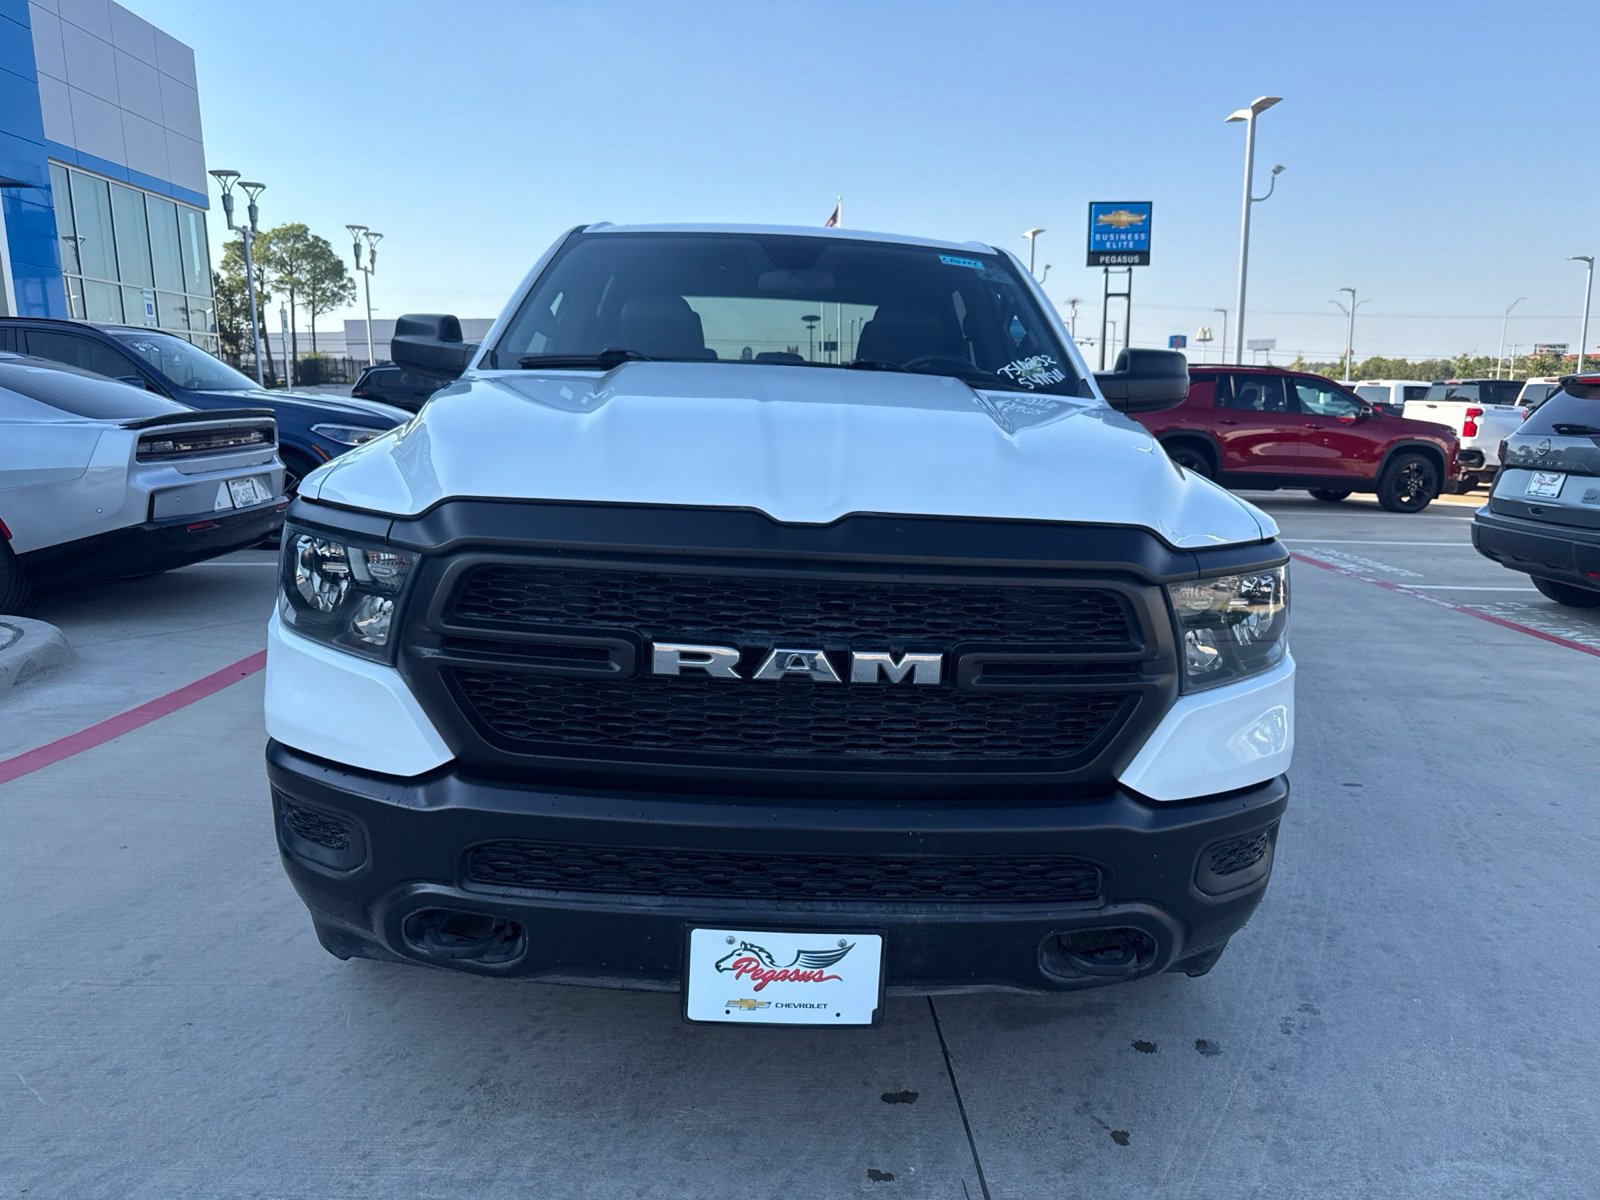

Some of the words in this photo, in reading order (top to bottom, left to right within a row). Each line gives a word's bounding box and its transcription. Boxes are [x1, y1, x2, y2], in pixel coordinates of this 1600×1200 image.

[1095, 232, 1146, 241] BUSINESS
[1106, 241, 1134, 249] ELITE
[1099, 255, 1140, 264] PEGASUS
[652, 642, 943, 685] RAM
[731, 956, 843, 992] Pegasus
[775, 1002, 829, 1010] CHEVROLET
